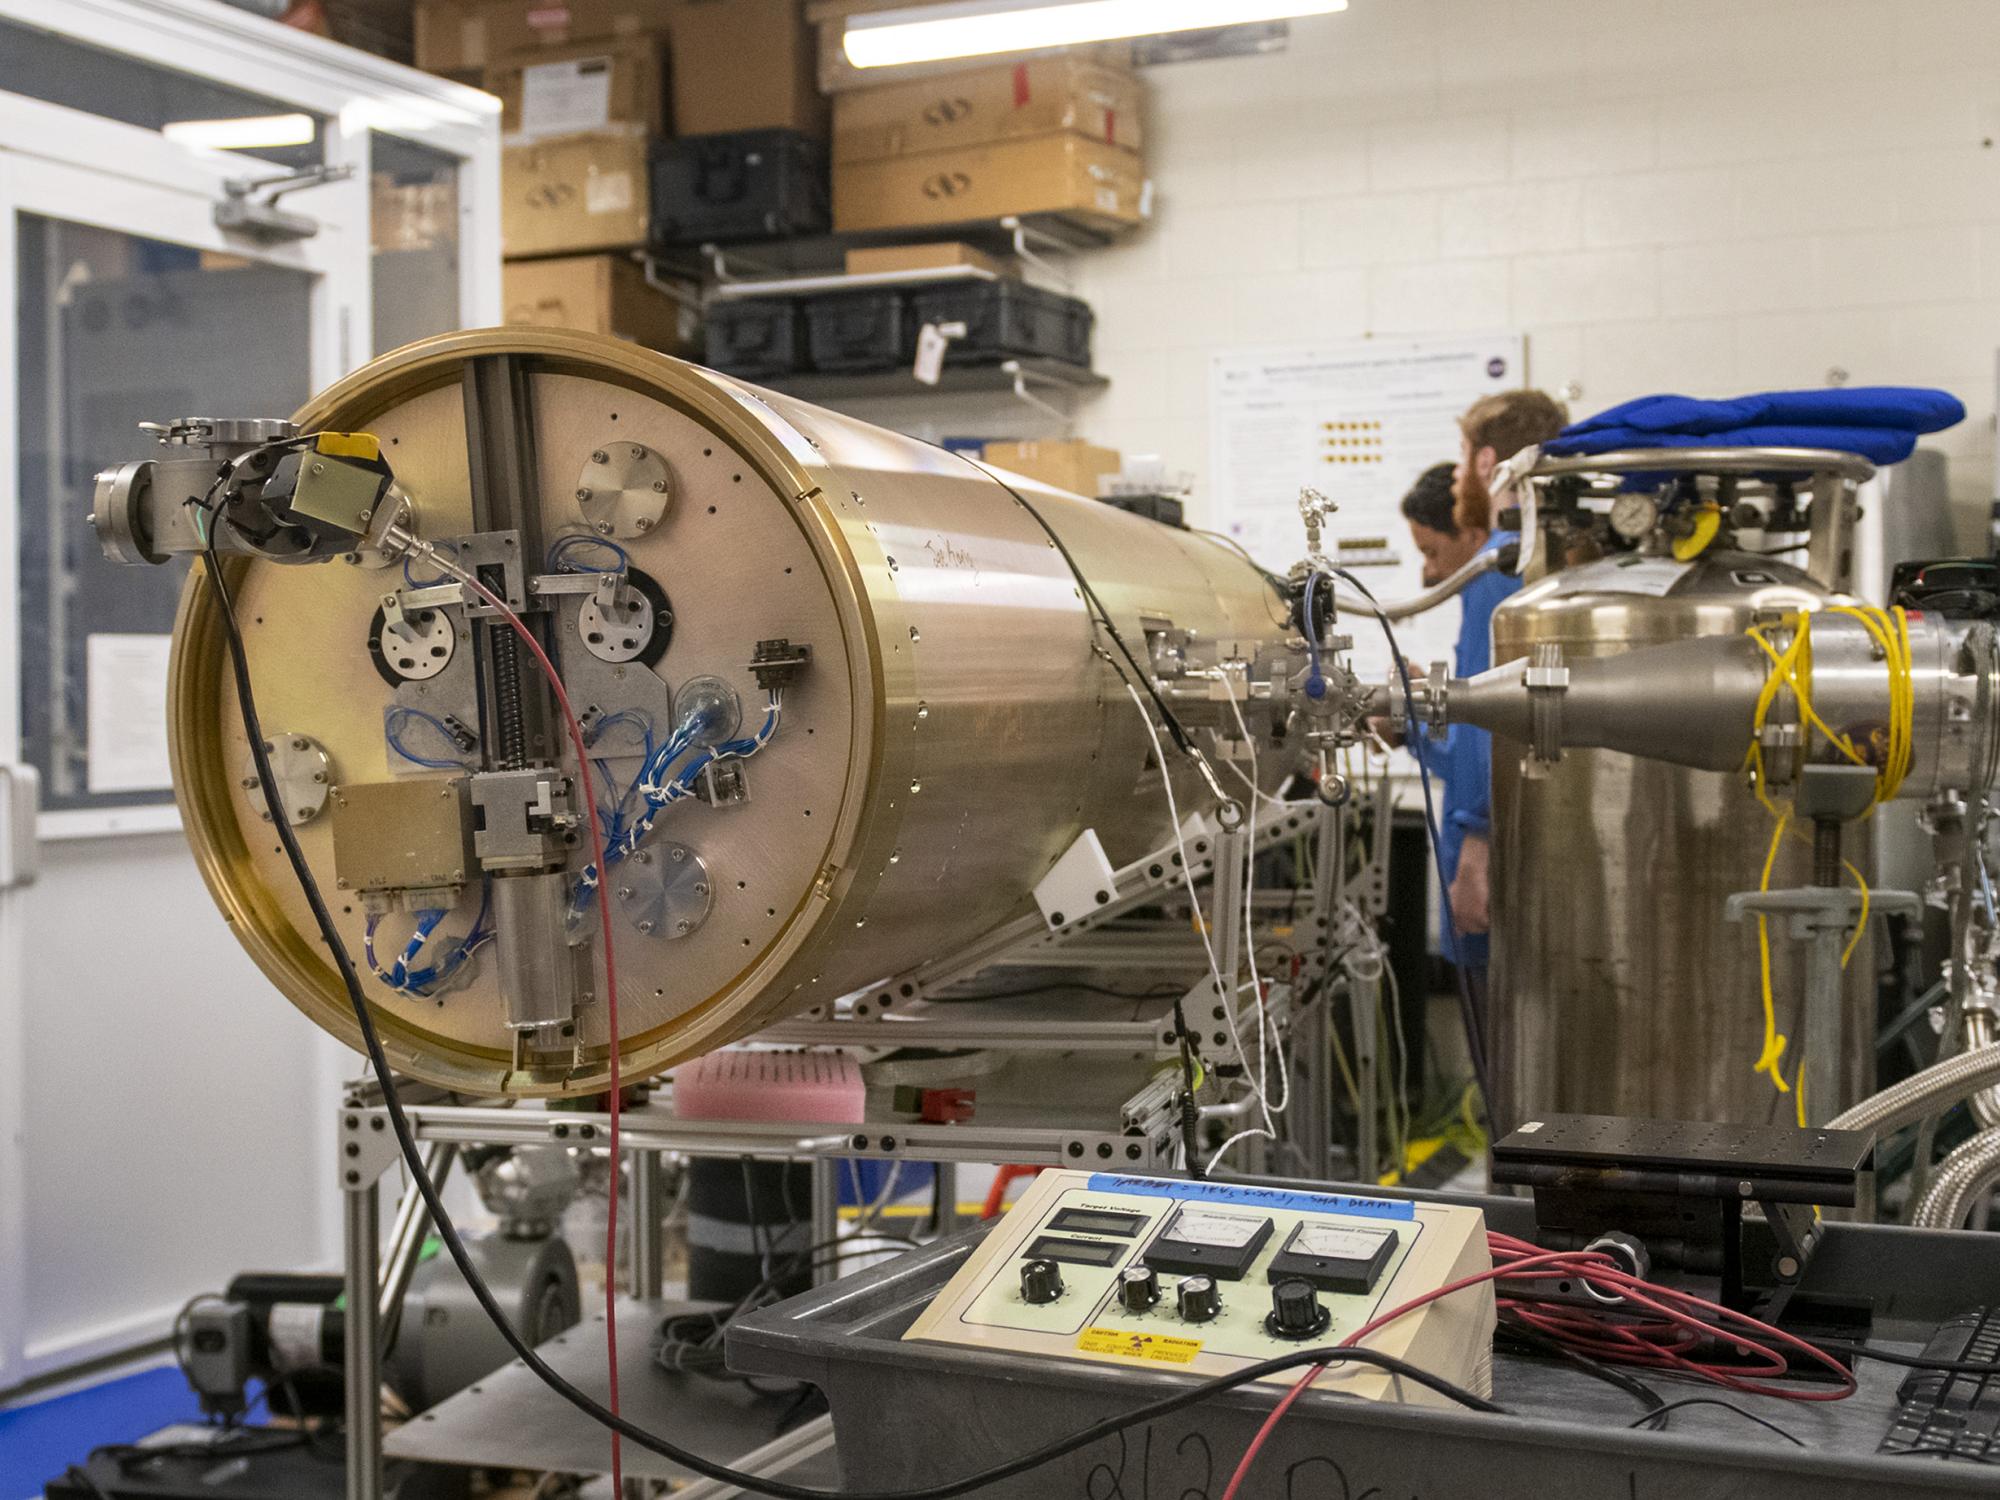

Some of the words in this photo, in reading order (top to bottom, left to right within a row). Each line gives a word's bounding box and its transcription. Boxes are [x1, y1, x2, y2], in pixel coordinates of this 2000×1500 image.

[1080, 1202, 1107, 1210] Target
[1070, 1233, 1102, 1241] Current
[1090, 1329, 1119, 1337] CAUTION
[1163, 1338, 1199, 1347] RADIATION
